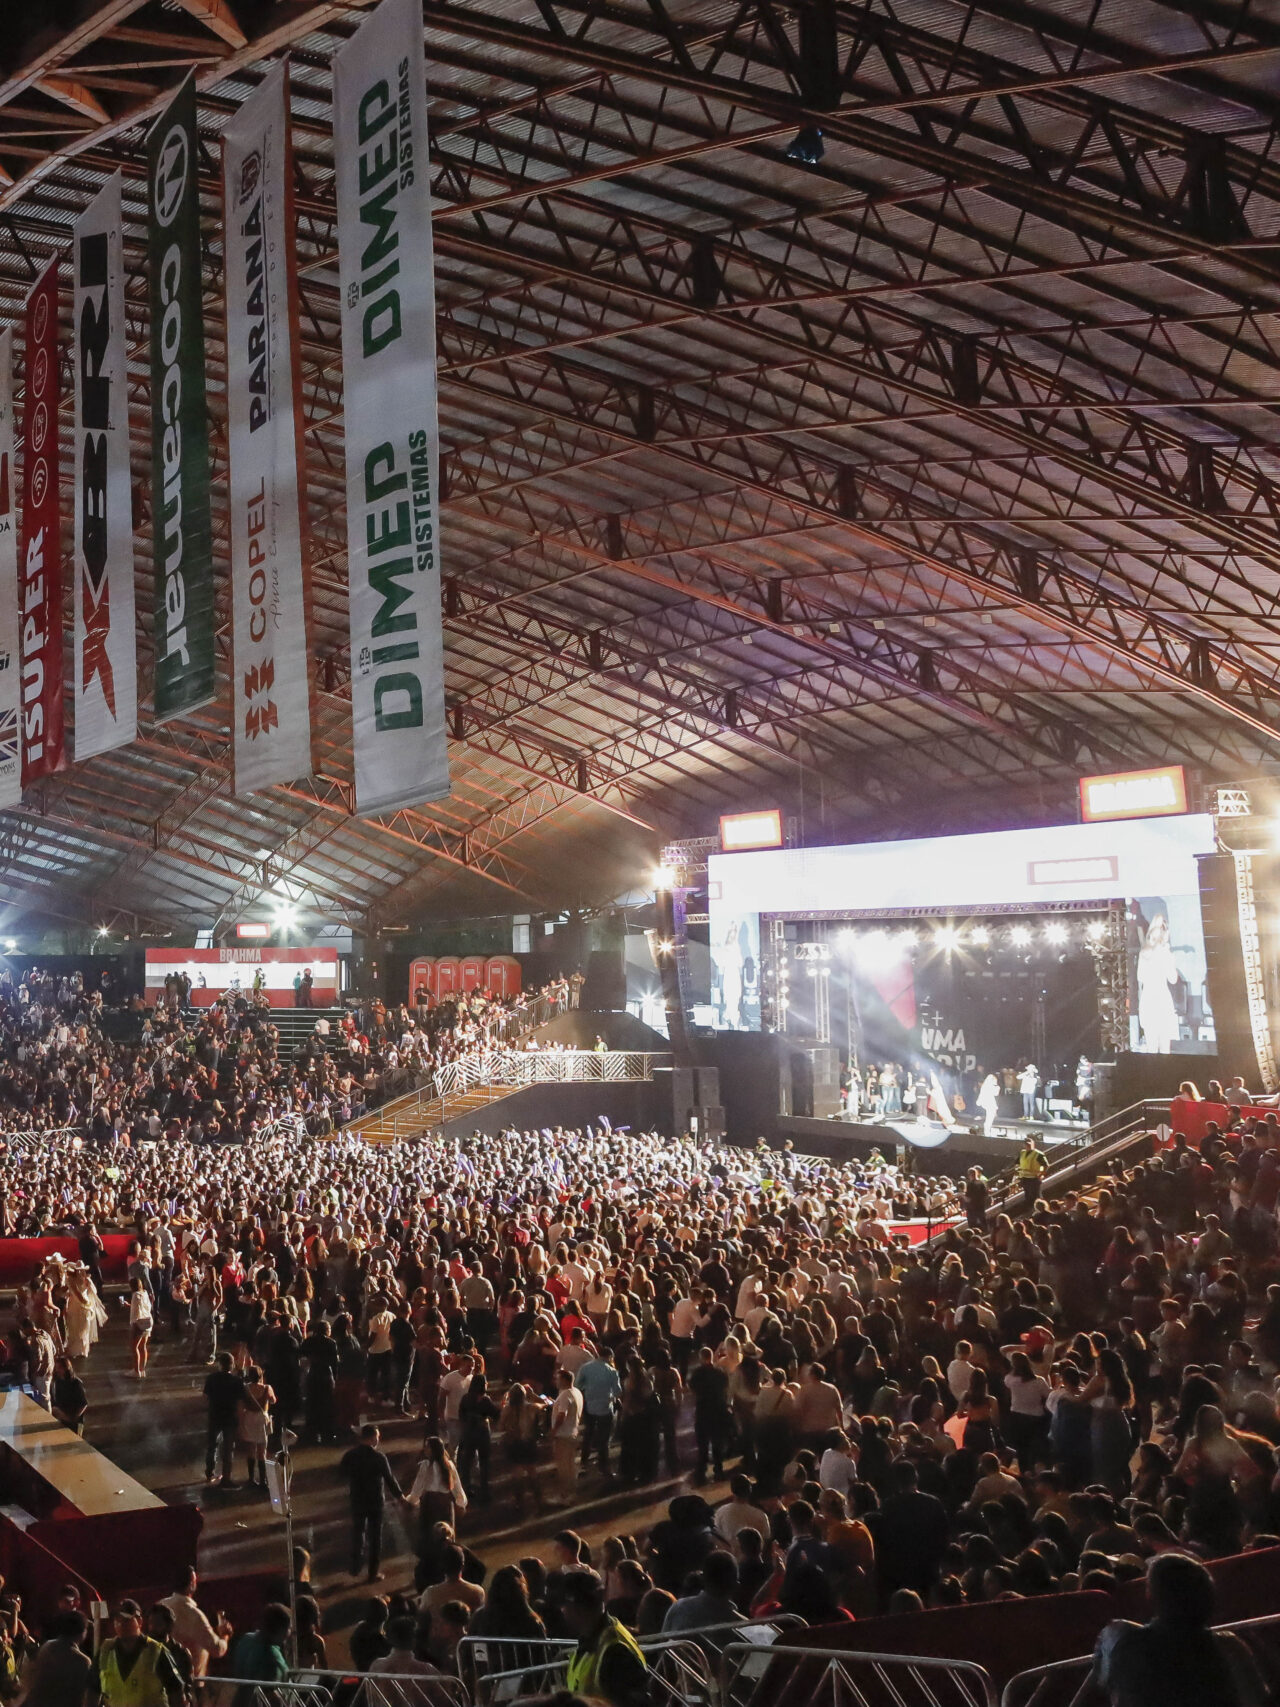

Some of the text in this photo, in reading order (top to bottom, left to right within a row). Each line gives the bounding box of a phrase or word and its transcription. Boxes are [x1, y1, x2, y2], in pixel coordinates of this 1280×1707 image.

[358, 78, 402, 359] DIMEP
[398, 56, 415, 191] SISTEMAS
[240, 195, 267, 434] PARANÁ
[80, 233, 117, 724] XBRI
[161, 243, 190, 668] cocamar
[408, 429, 434, 572] SISTEMAS
[247, 476, 267, 643] COPEL
[365, 441, 424, 732] DIMEP
[219, 948, 262, 963] BRAHMA
[921, 1027, 966, 1052] UMA
